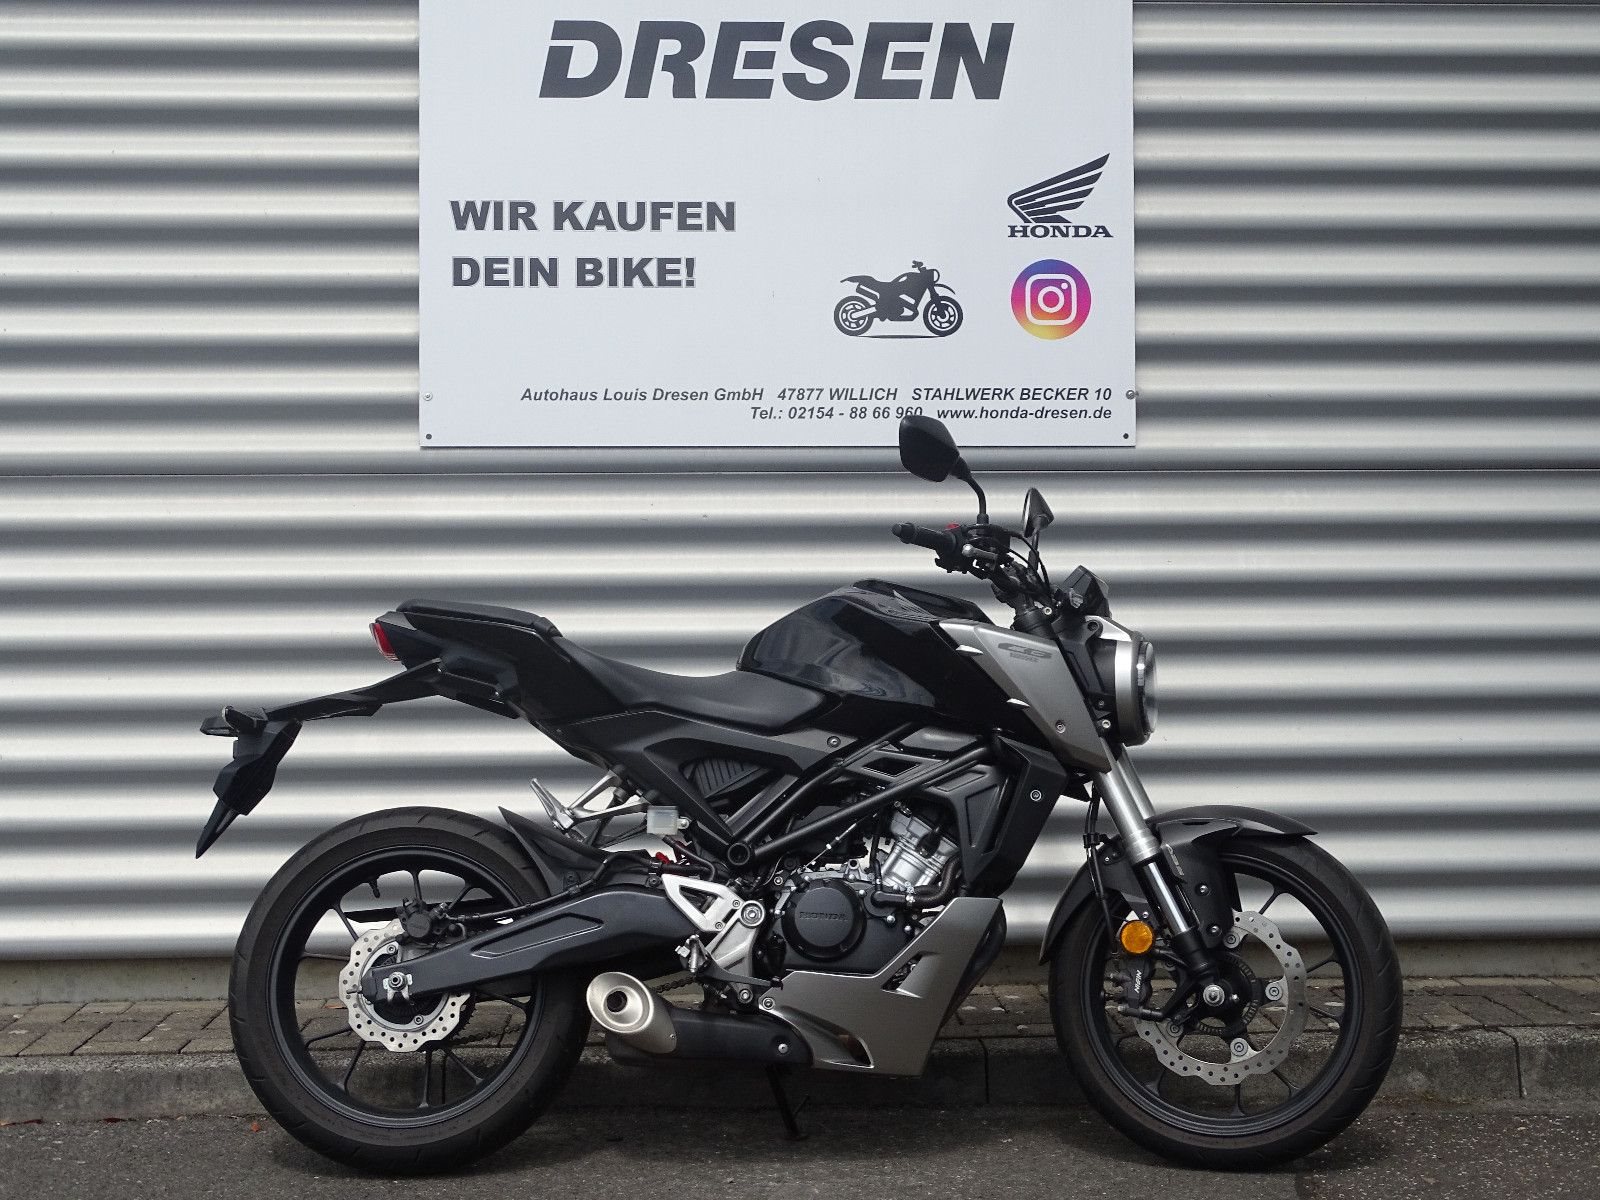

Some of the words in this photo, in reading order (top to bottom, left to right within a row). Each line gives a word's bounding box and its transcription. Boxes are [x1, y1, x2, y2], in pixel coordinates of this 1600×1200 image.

[539, 20, 1014, 101] DRESEN
[450, 201, 537, 231] WIR
[554, 201, 735, 231] KAUFEN
[1008, 224, 1113, 239] HONDA
[453, 257, 557, 287] DEIN
[576, 257, 695, 288] BIKE!
[521, 388, 598, 402] Autohaus
[603, 388, 648, 402] Louis
[652, 388, 708, 401] Dresen
[713, 388, 764, 401] GmbH
[777, 388, 824, 401] 47877
[829, 388, 898, 401] WILLICH
[911, 388, 1015, 401] STAHLWERK
[1019, 388, 1089, 401] BECKER
[1094, 388, 1112, 401] 10
[751, 406, 783, 420] Tel.:
[787, 406, 834, 420] 02154
[849, 406, 867, 420] 88
[872, 406, 891, 420] 66
[937, 406, 1112, 420] www.honda-dresen.de
